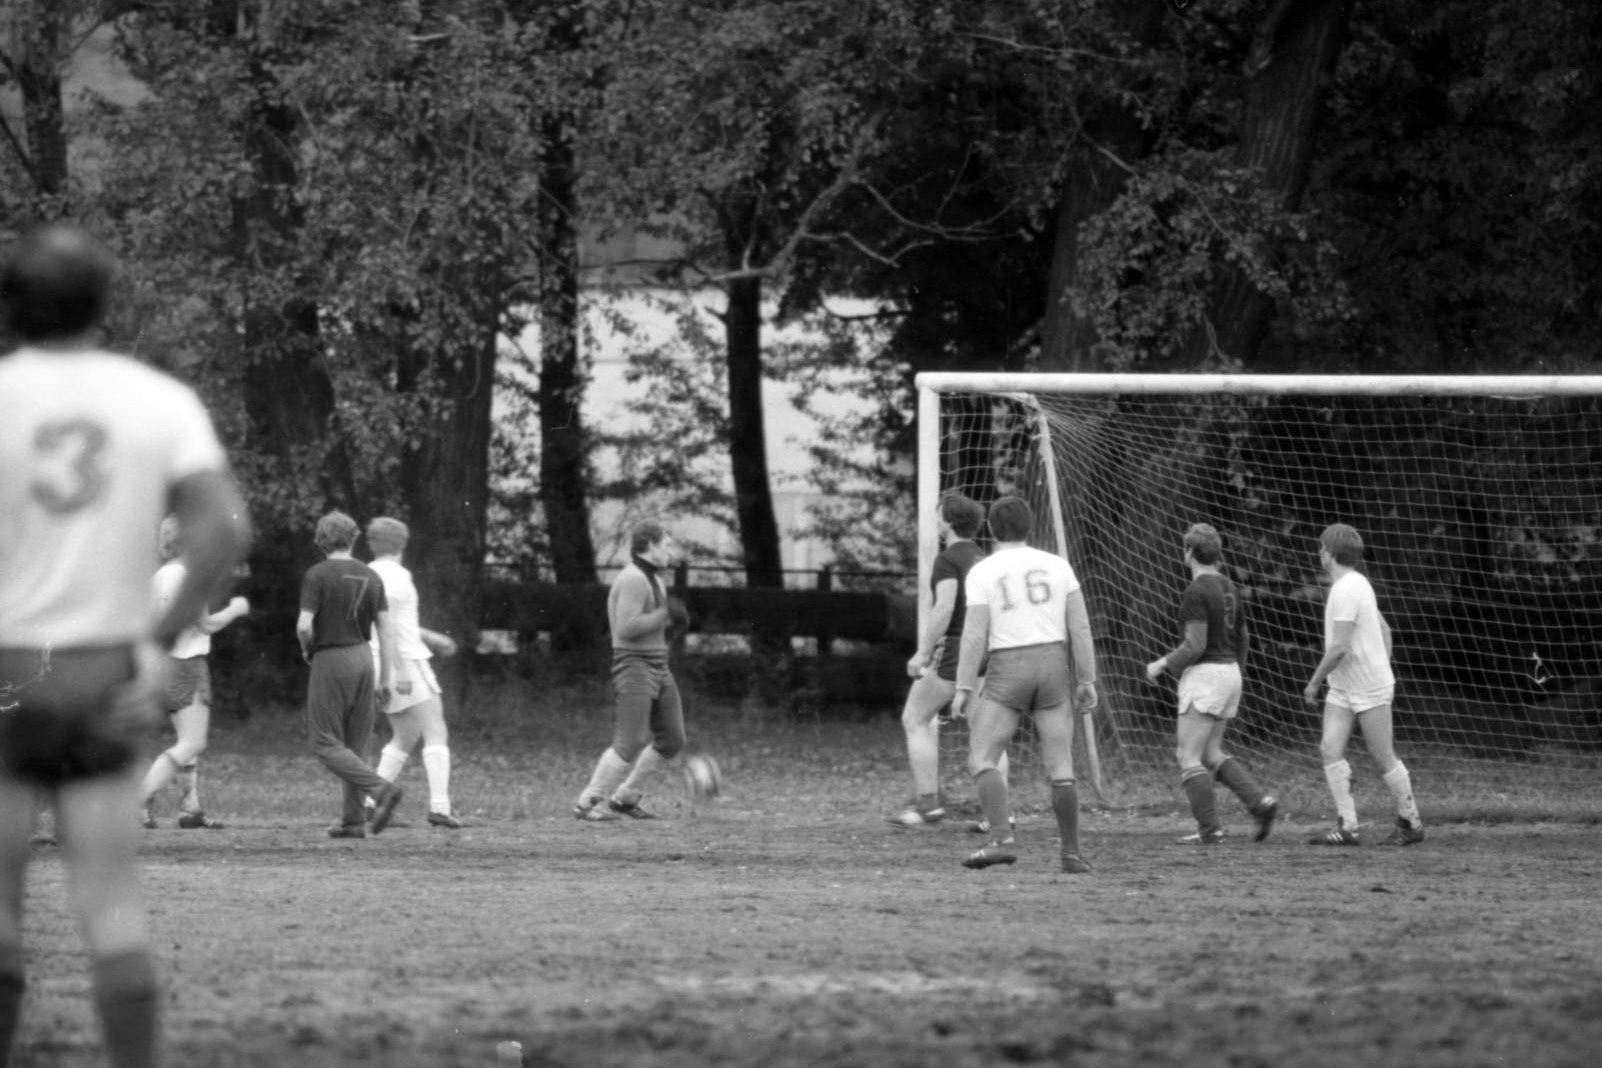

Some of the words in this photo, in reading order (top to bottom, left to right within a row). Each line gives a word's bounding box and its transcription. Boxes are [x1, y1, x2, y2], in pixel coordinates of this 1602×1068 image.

[33, 416, 108, 514] 3
[342, 574, 369, 619] 7
[997, 569, 1052, 613] 16
